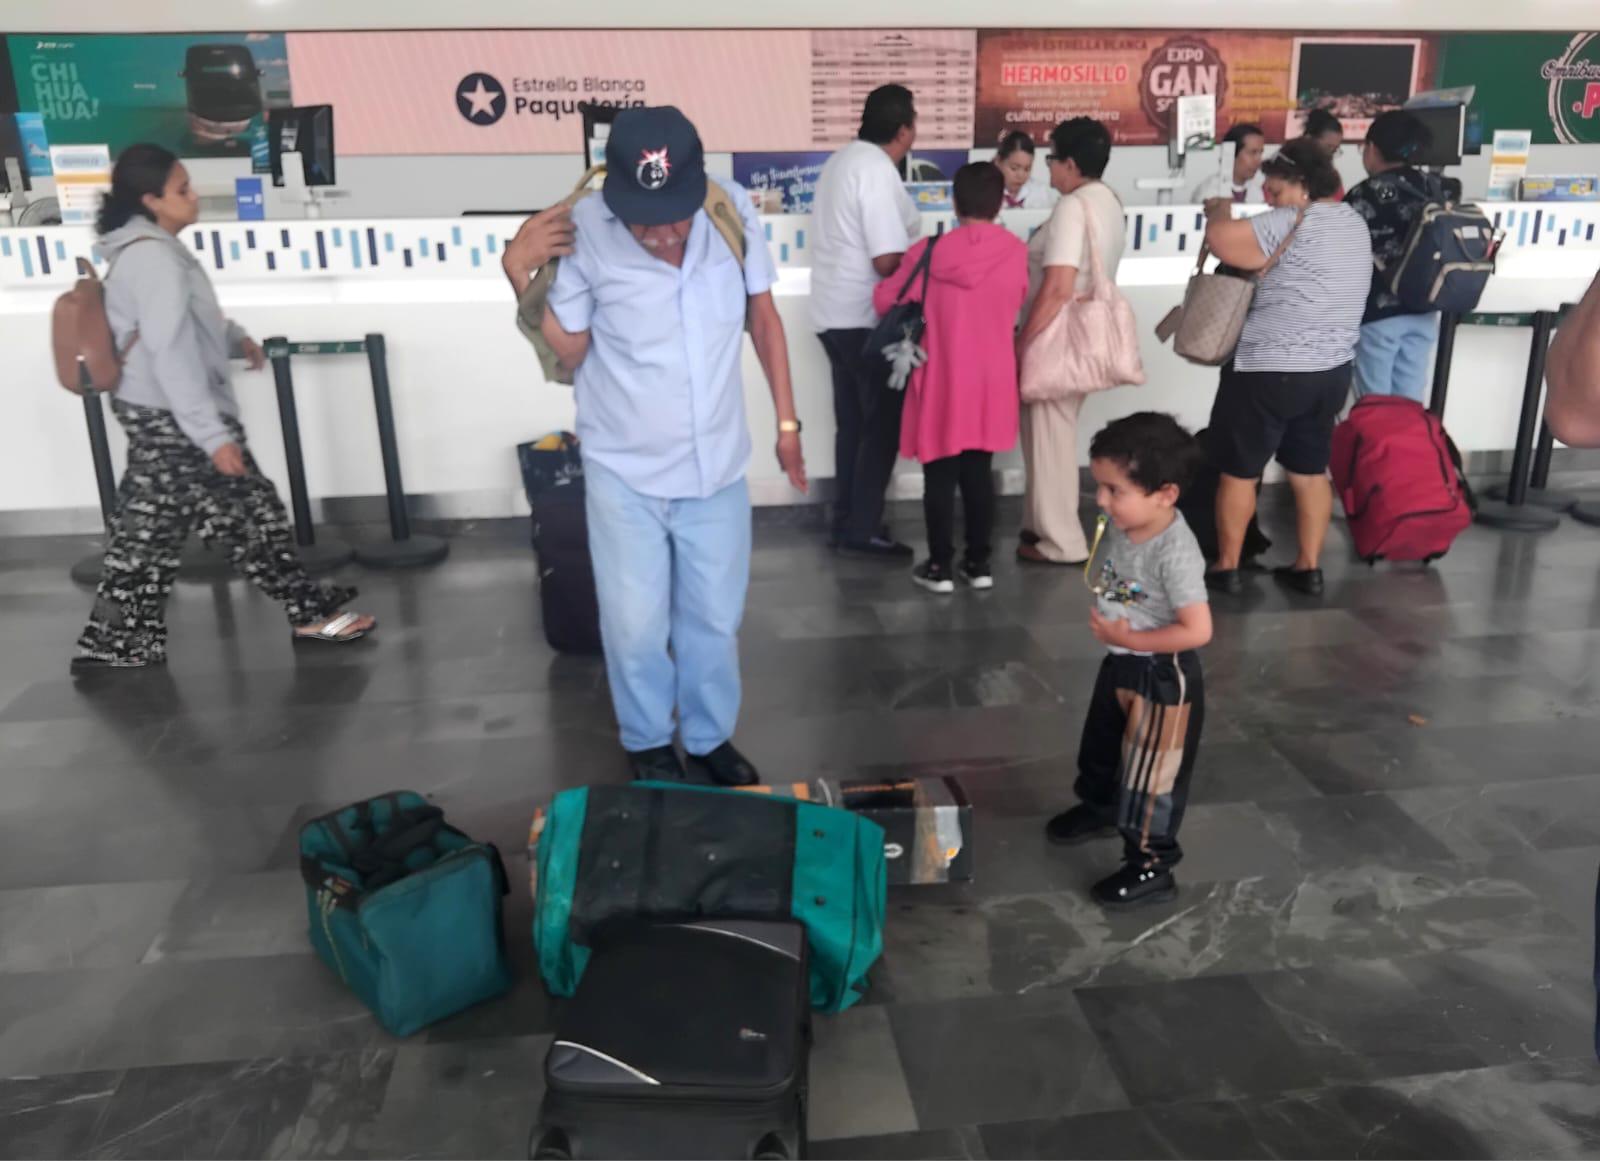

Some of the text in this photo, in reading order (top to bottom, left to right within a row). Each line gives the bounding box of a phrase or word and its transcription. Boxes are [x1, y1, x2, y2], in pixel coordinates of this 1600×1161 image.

[1167, 48, 1204, 62] EXPO
[31, 62, 77, 82] CHI
[1003, 63, 1128, 83] HERMOSILLO
[1150, 64, 1219, 97] GAN
[34, 81, 89, 101] HUA
[513, 77, 646, 92] Estrella Blanca
[38, 98, 99, 120] HUA!
[1005, 110, 1053, 122] cultura
